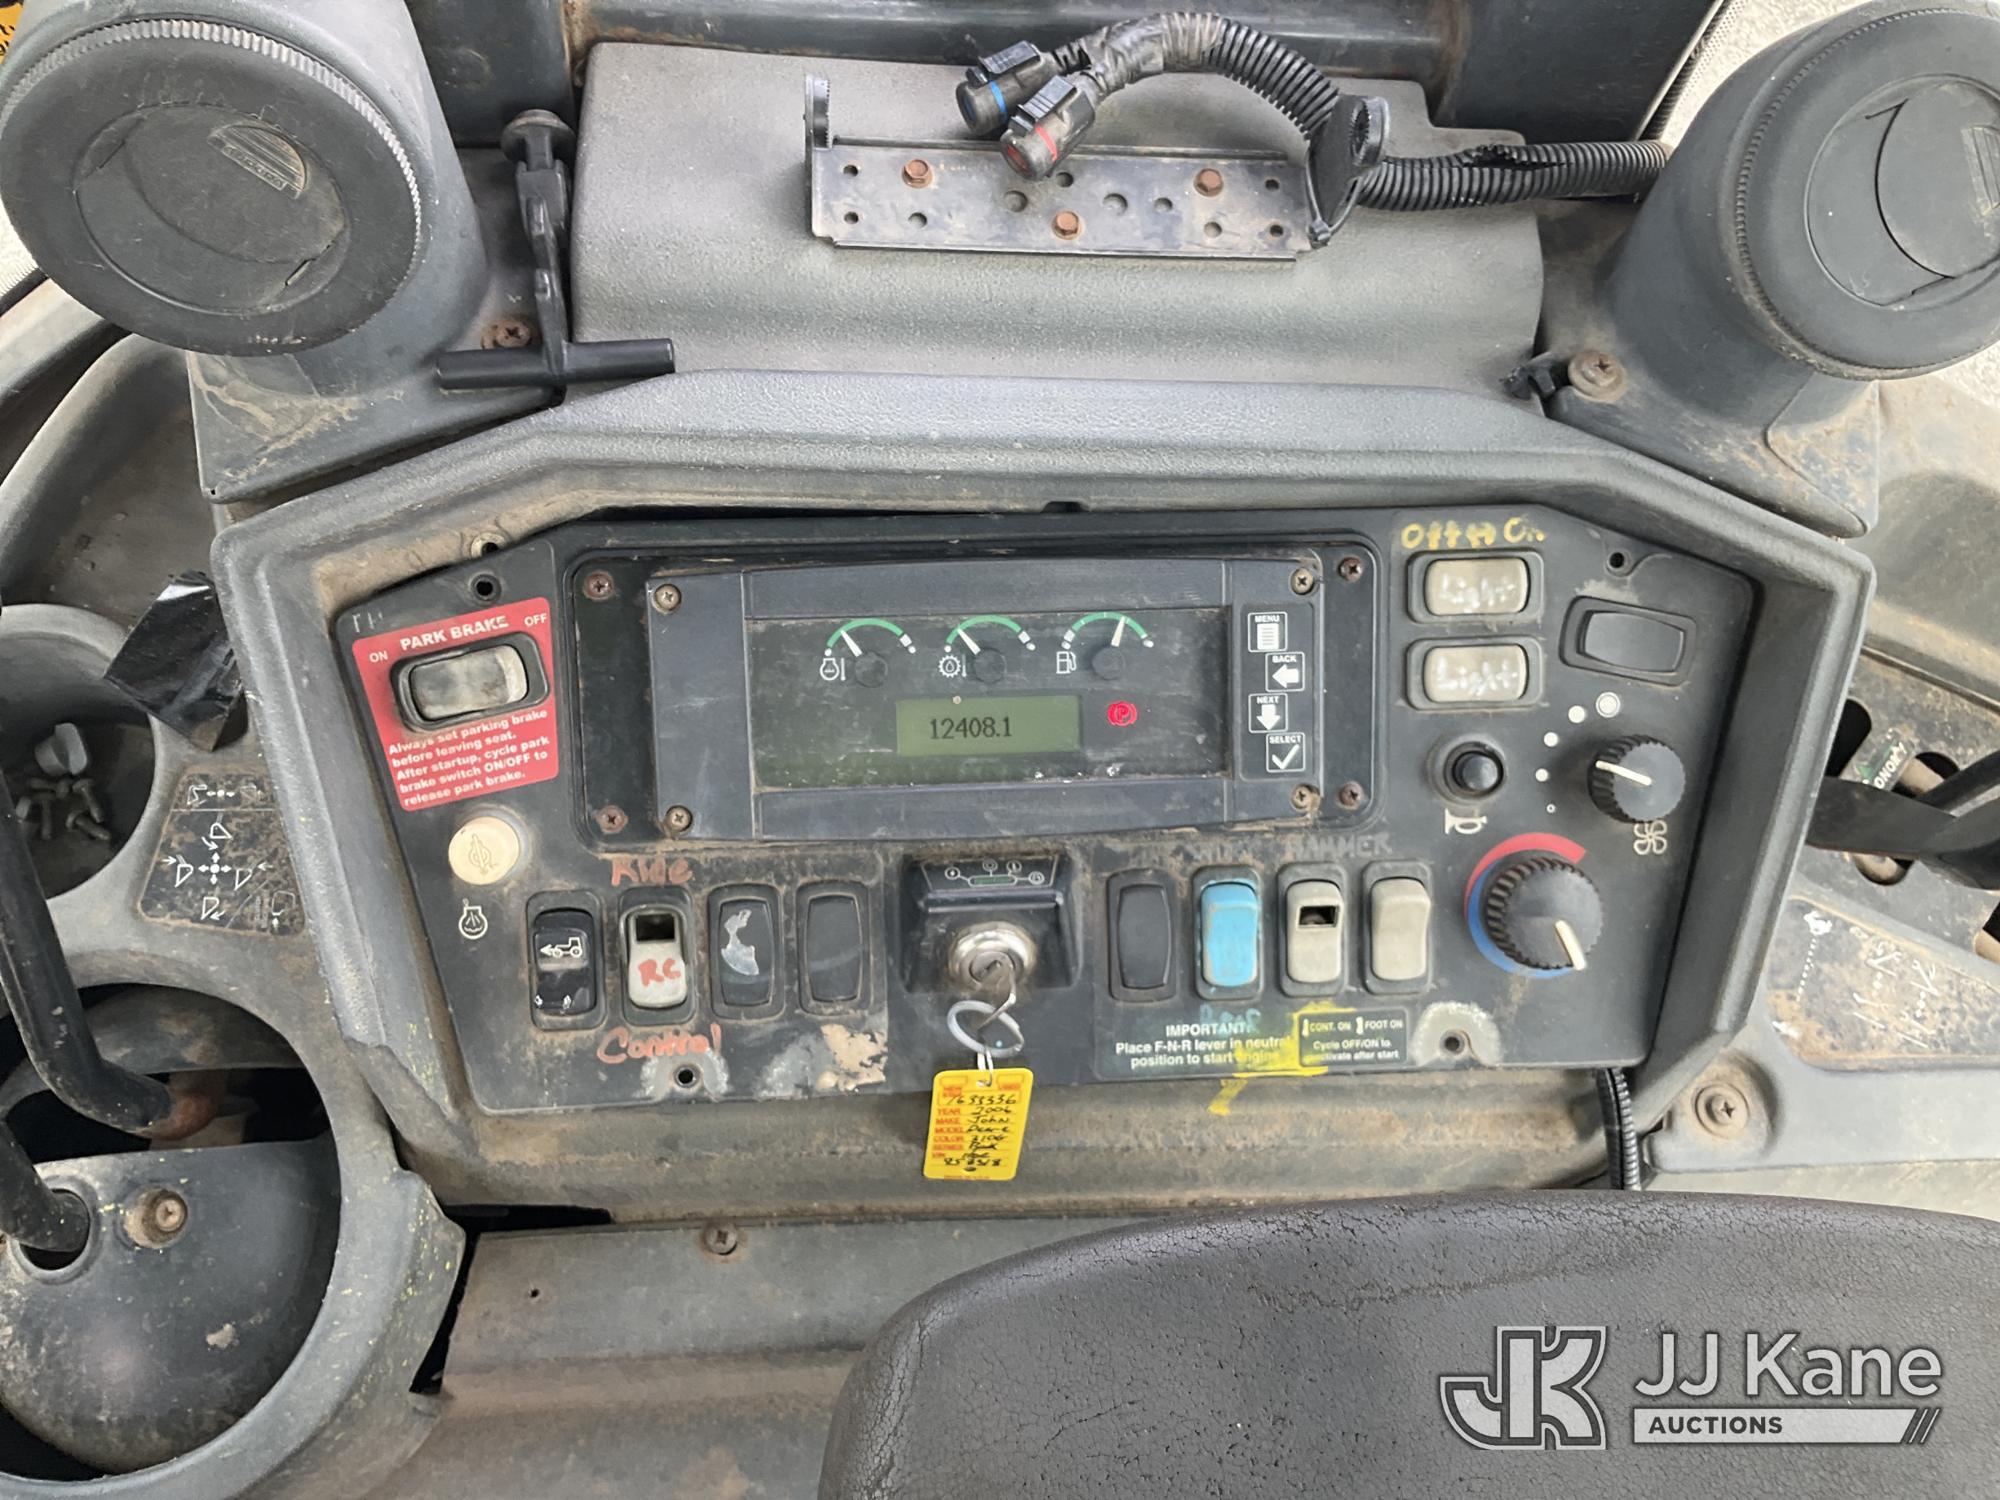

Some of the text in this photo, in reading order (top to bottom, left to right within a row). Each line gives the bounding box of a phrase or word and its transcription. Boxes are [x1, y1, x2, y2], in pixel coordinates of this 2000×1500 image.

[523, 612, 548, 628] OFF
[1254, 614, 1280, 623] MENU
[400, 615, 510, 651] PARK BRAKE
[369, 650, 388, 663] ON
[1271, 654, 1297, 663] BACK
[1436, 655, 1518, 696] Light
[1256, 695, 1280, 705] NEXT
[388, 709, 548, 756] Always set parking brake
[929, 715, 1013, 740] 12408.1
[391, 730, 517, 768] before leaving seat.
[1269, 734, 1302, 744] SELECT
[397, 735, 550, 781] After startup, cycle park
[400, 751, 548, 794] brake switch ON/OFF to
[404, 770, 525, 806] release park brake.
[638, 958, 682, 987] RC
[1309, 1018, 1403, 1033] CONT. ON FOOT ON
[596, 1022, 722, 1065] Control
[1115, 1041, 1152, 1055] Place
[1154, 1039, 1192, 1053] F-N-R
[1194, 1038, 1227, 1051] lever
[1229, 1037, 1243, 1049] in
[1380, 1037, 1392, 1048] to
[1130, 1050, 1281, 1070] position to start ngin
